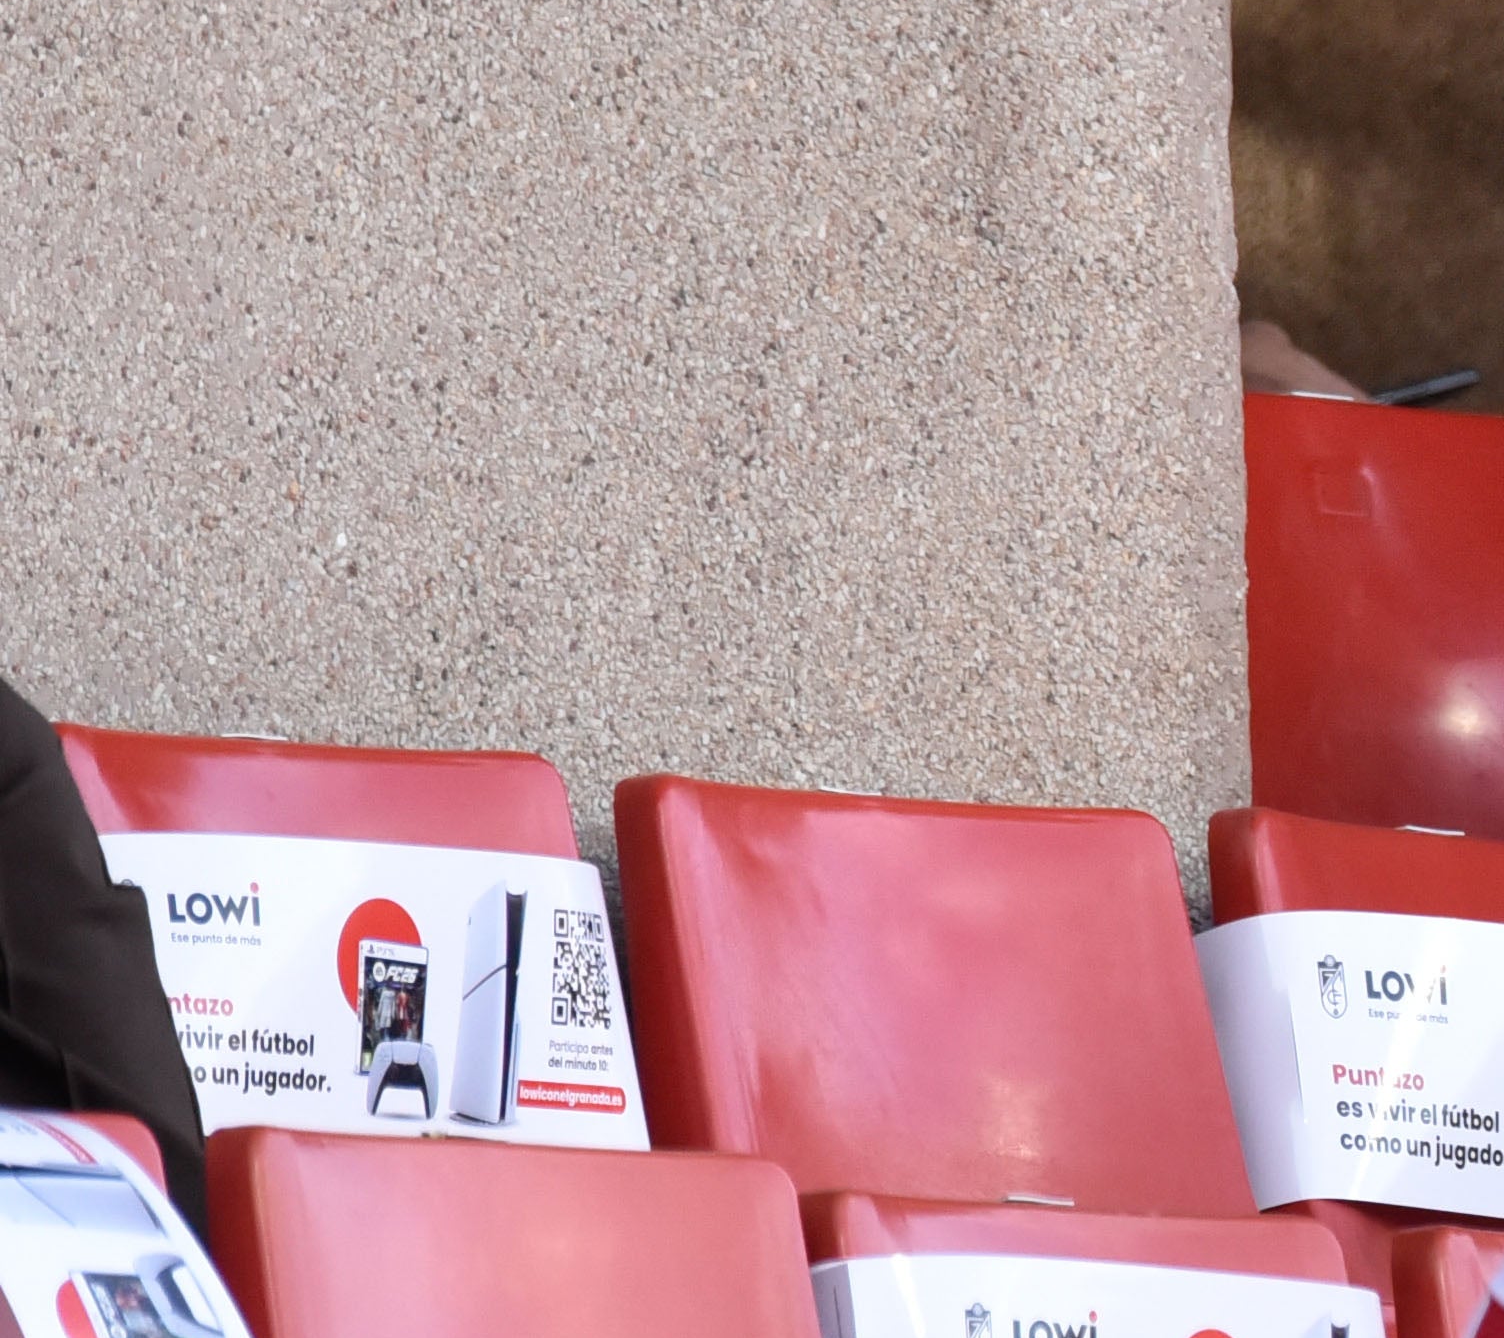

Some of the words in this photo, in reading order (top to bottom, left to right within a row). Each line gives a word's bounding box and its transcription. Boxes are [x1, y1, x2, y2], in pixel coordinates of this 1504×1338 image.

[171, 932, 189, 943] Ese
[192, 933, 223, 945] punto
[225, 934, 238, 945] de
[240, 934, 262, 946] más
[167, 992, 234, 1016] ntazo
[228, 1029, 247, 1052] el
[252, 1029, 315, 1057] fútbol
[548, 1057, 564, 1069] del
[565, 1057, 597, 1071] minuto
[212, 1066, 239, 1086] un
[243, 1062, 332, 1096] jugador.
[1336, 1099, 1363, 1118] es
[1420, 1104, 1438, 1126] el
[1441, 1104, 1500, 1133] fútbol
[1406, 1137, 1432, 1158] un
